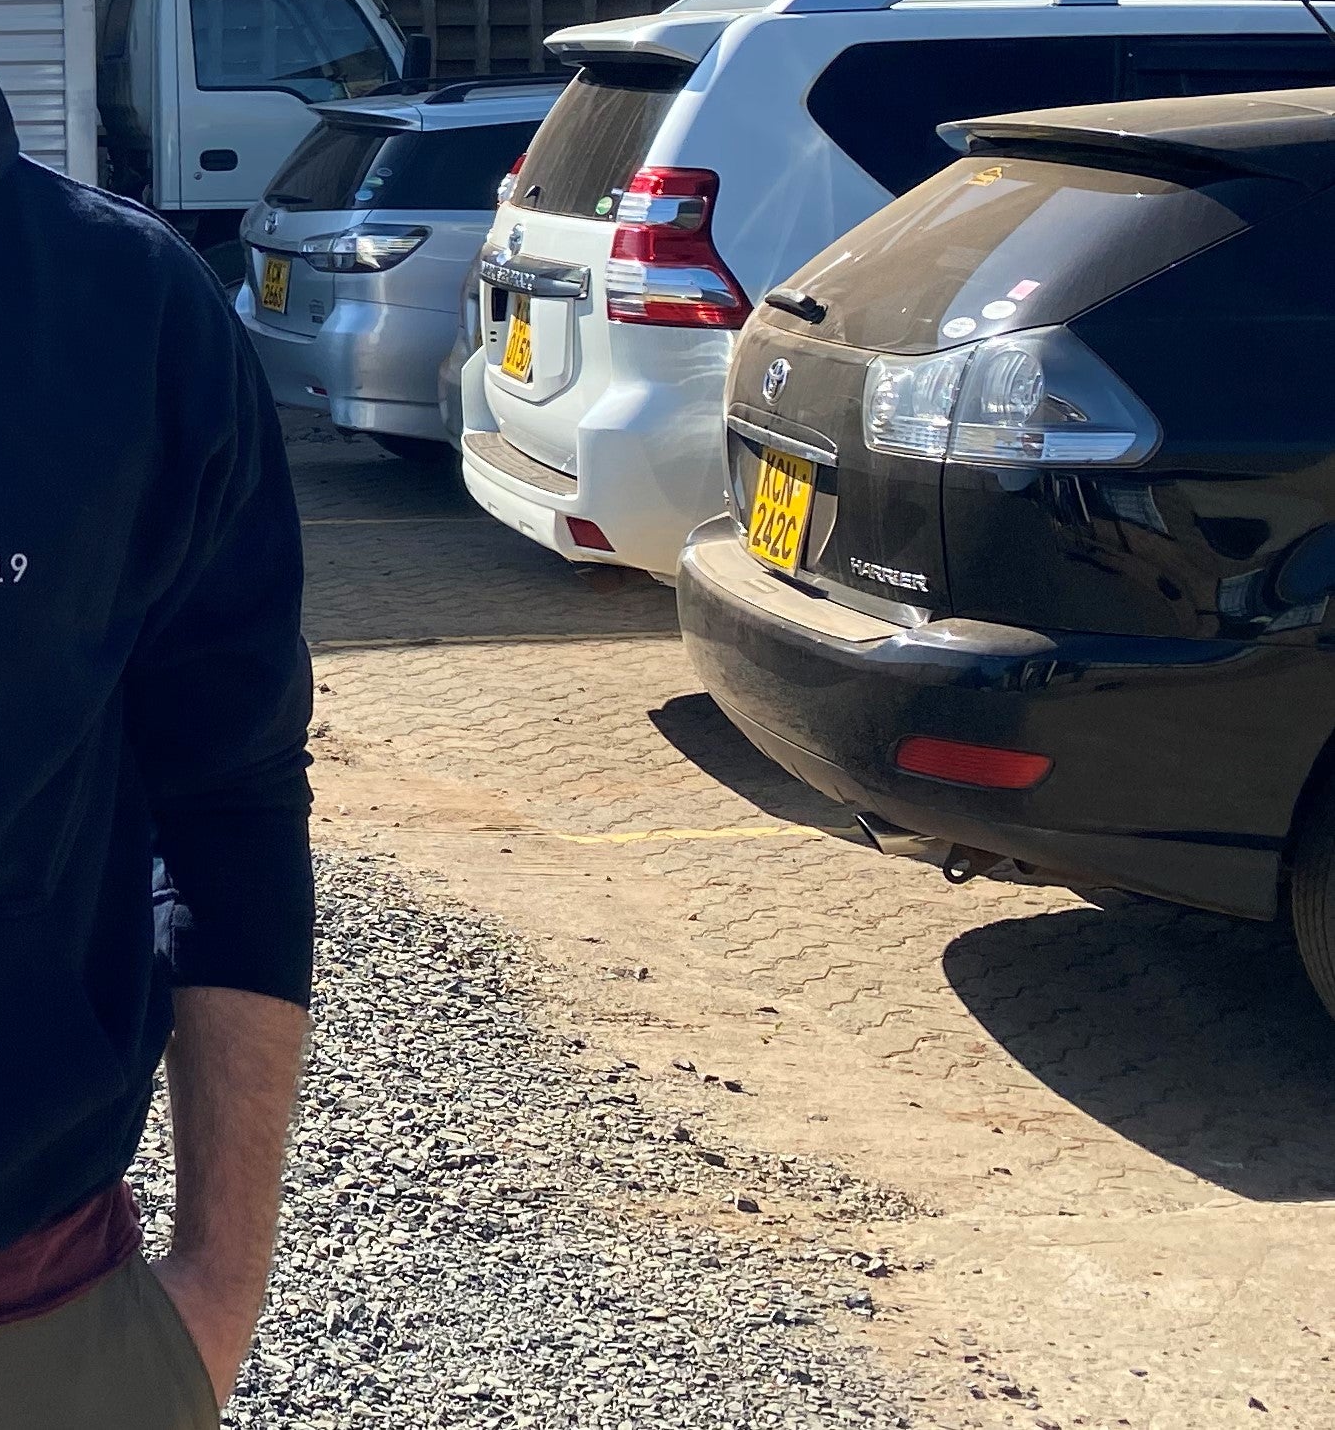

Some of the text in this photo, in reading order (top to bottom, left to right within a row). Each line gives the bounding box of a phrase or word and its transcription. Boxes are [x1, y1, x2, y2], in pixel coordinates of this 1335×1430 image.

[760, 452, 798, 509] KCN
[751, 501, 798, 560] 242C
[849, 557, 929, 593] HARRIER
